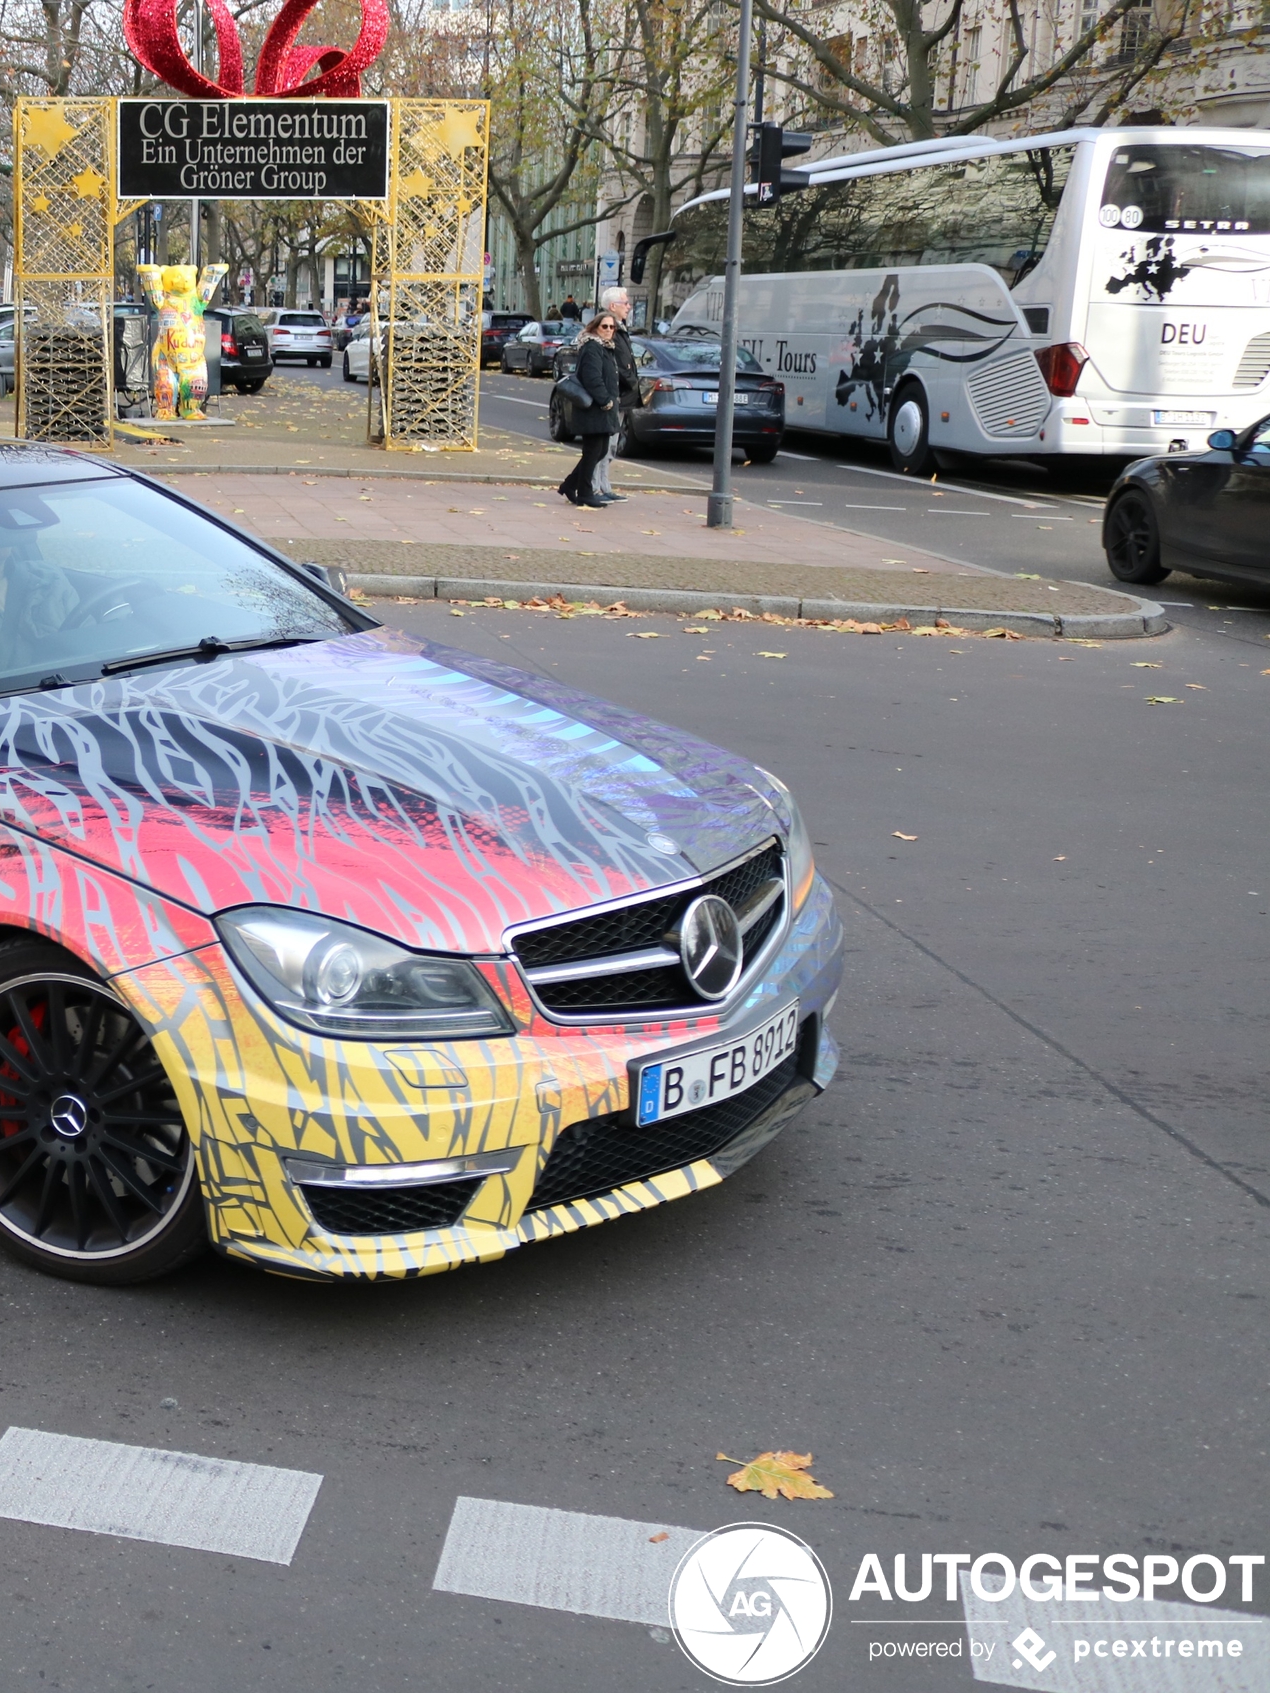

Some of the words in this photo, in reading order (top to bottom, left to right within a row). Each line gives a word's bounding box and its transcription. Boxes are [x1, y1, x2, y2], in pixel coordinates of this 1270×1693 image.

[139, 103, 191, 139] CG
[200, 103, 368, 139] Elementum
[141, 139, 178, 164] Ein
[185, 139, 327, 164] Unternehmen
[332, 139, 367, 165] der
[180, 164, 255, 189] Gröner
[261, 164, 328, 196] Group
[1102, 209, 1118, 223] 100
[1125, 210, 1139, 224] 80
[1164, 219, 1250, 231] SETRA
[1160, 323, 1207, 345] DEU
[776, 340, 817, 374] Tours
[645, 1101, 654, 1114] D
[664, 1066, 684, 1112] B
[708, 1045, 746, 1098] FB
[752, 1008, 797, 1077] 8912
